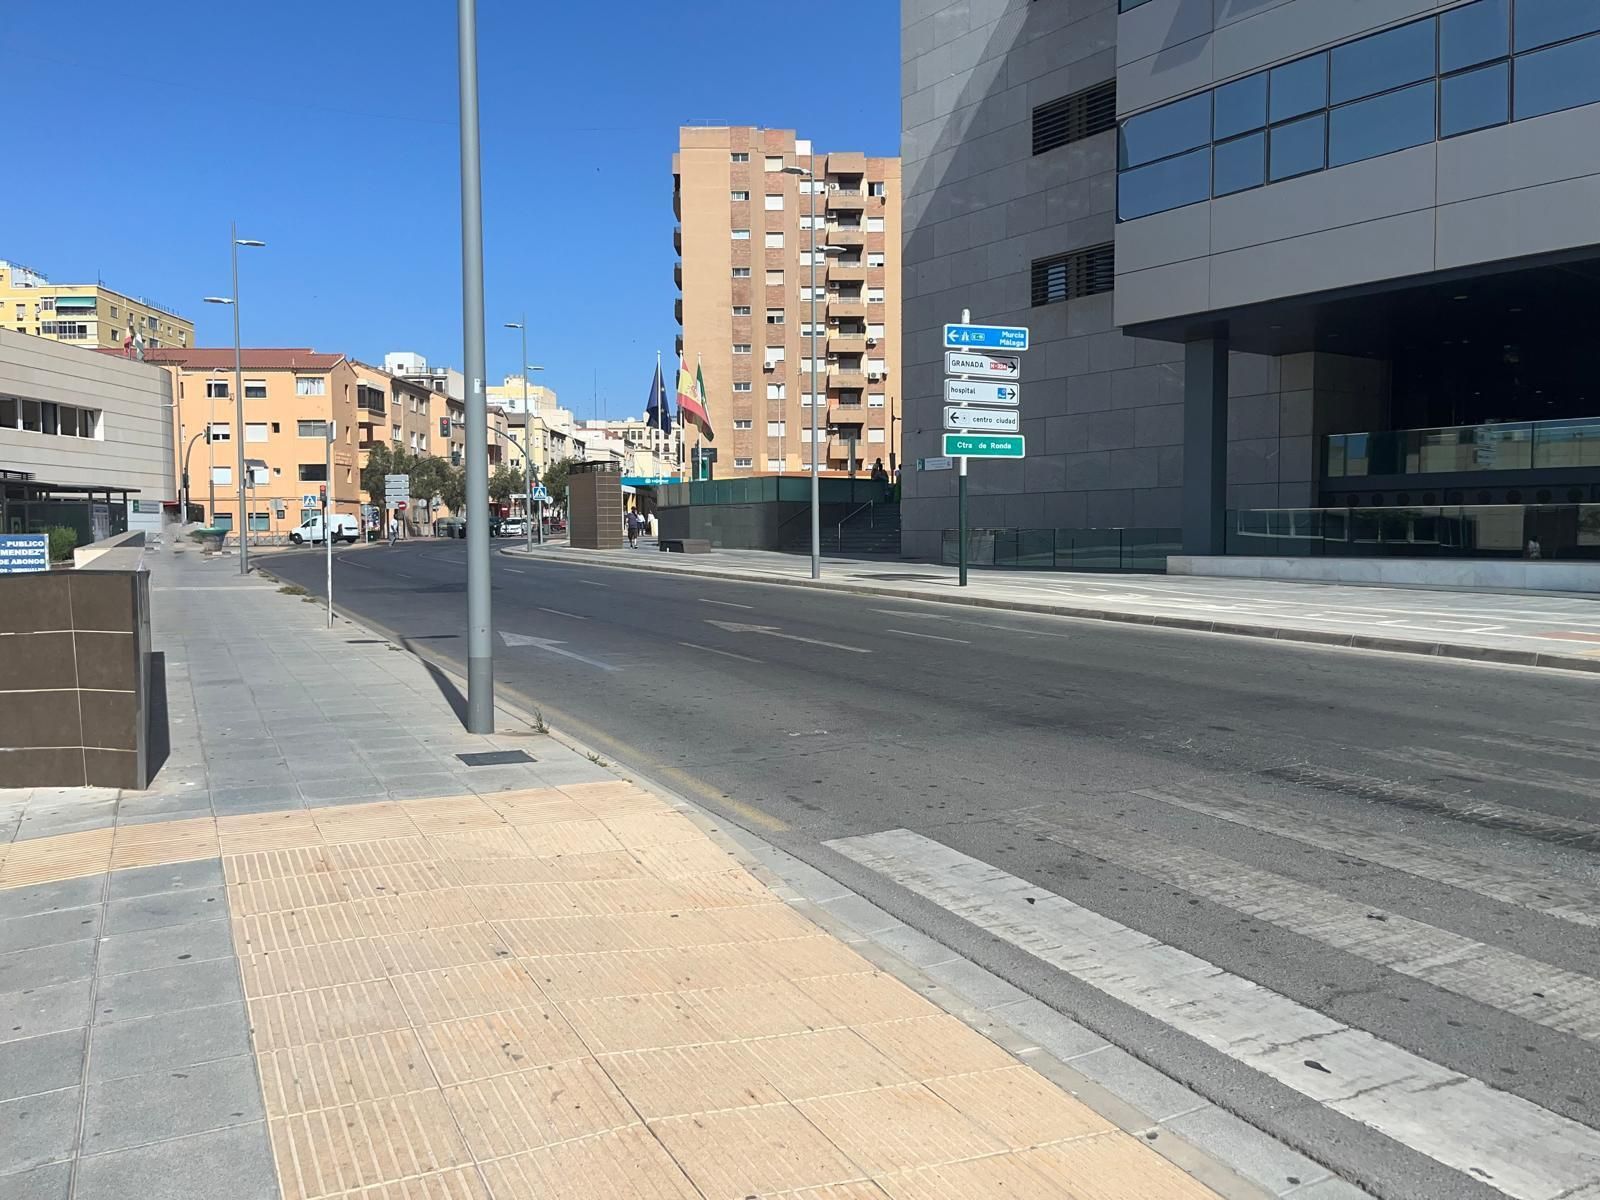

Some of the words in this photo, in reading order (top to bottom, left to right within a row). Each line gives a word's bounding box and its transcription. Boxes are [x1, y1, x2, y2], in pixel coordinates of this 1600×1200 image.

[1002, 330, 1024, 338] Murcia
[999, 338, 1024, 347] Málaga
[951, 360, 984, 368] GRANADA
